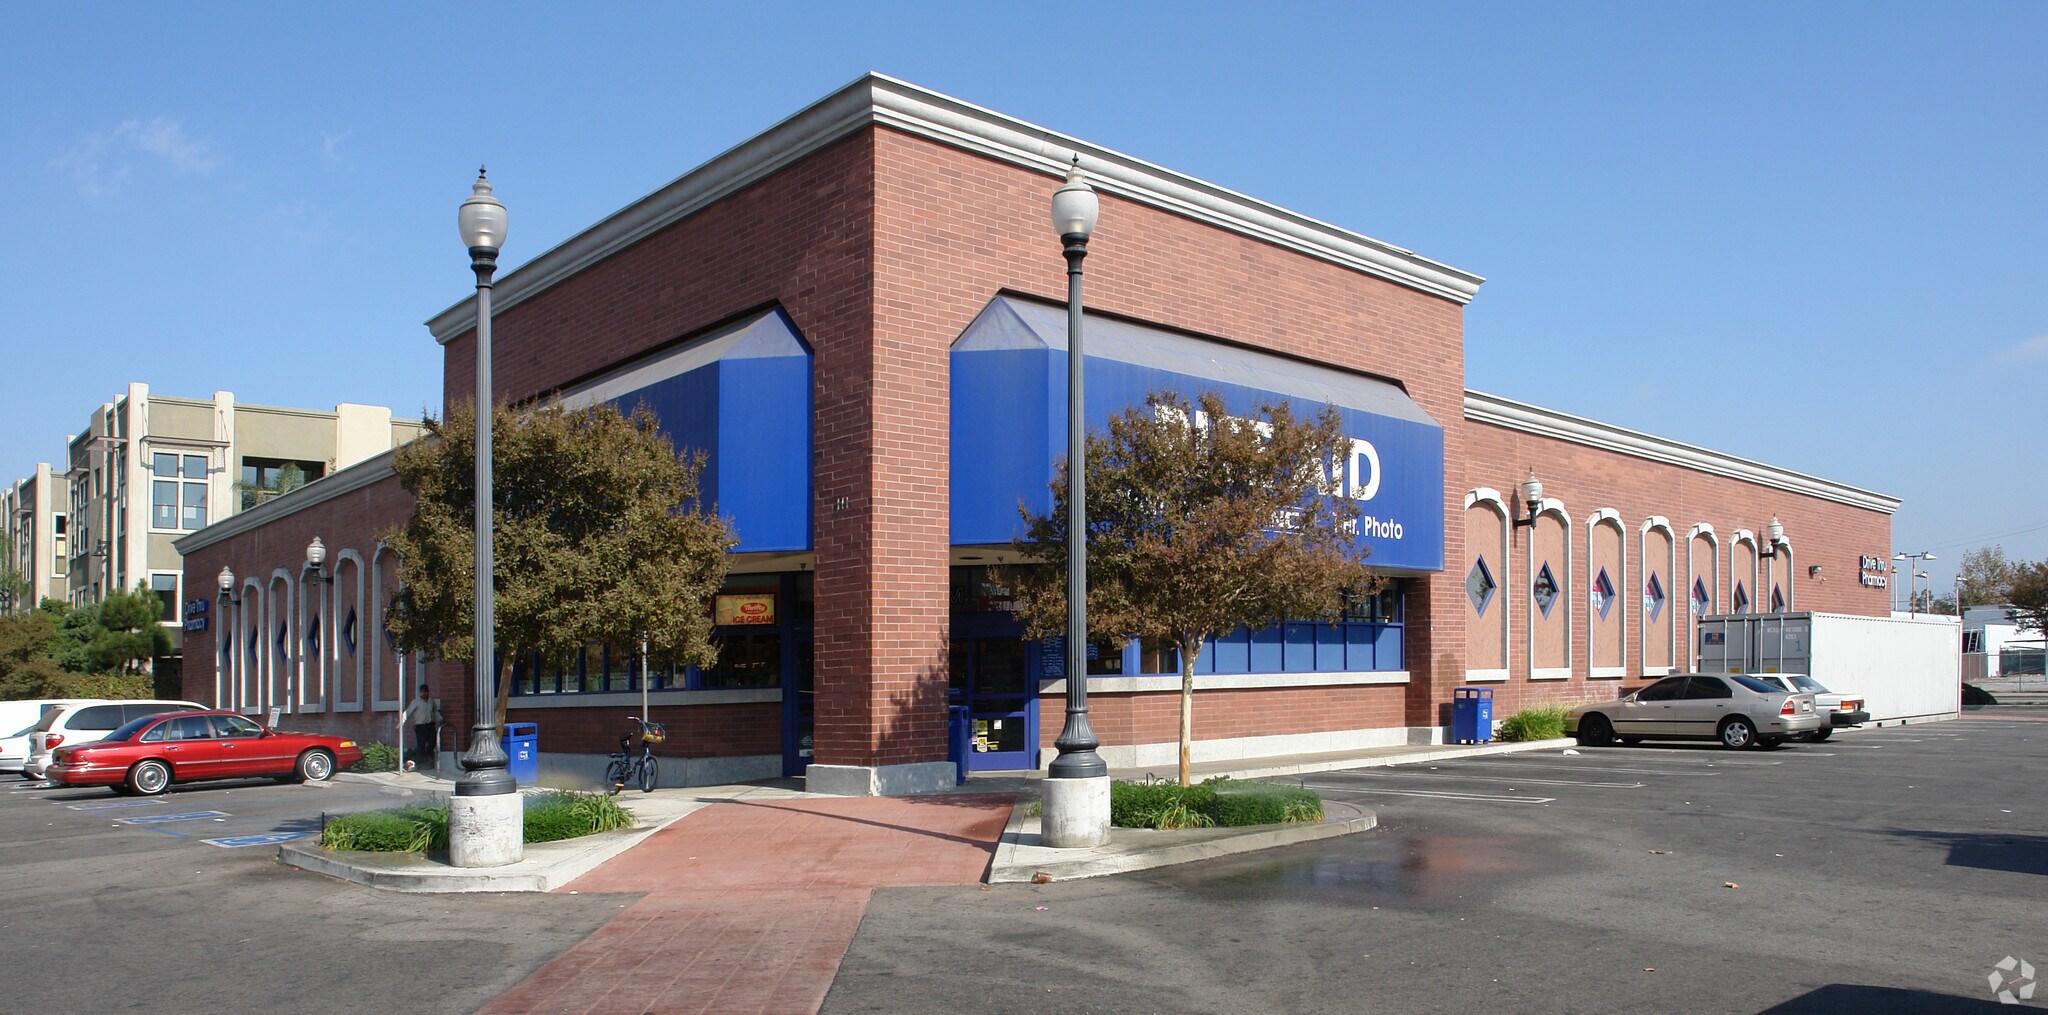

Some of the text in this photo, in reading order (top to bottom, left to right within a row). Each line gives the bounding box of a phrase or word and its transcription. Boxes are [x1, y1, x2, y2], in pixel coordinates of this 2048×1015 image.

[1364, 515, 1403, 540] Photo
[1862, 555, 1876, 569] Drive
[1862, 571, 1887, 589] Pharmacy
[733, 615, 773, 623] ICE CREAM
